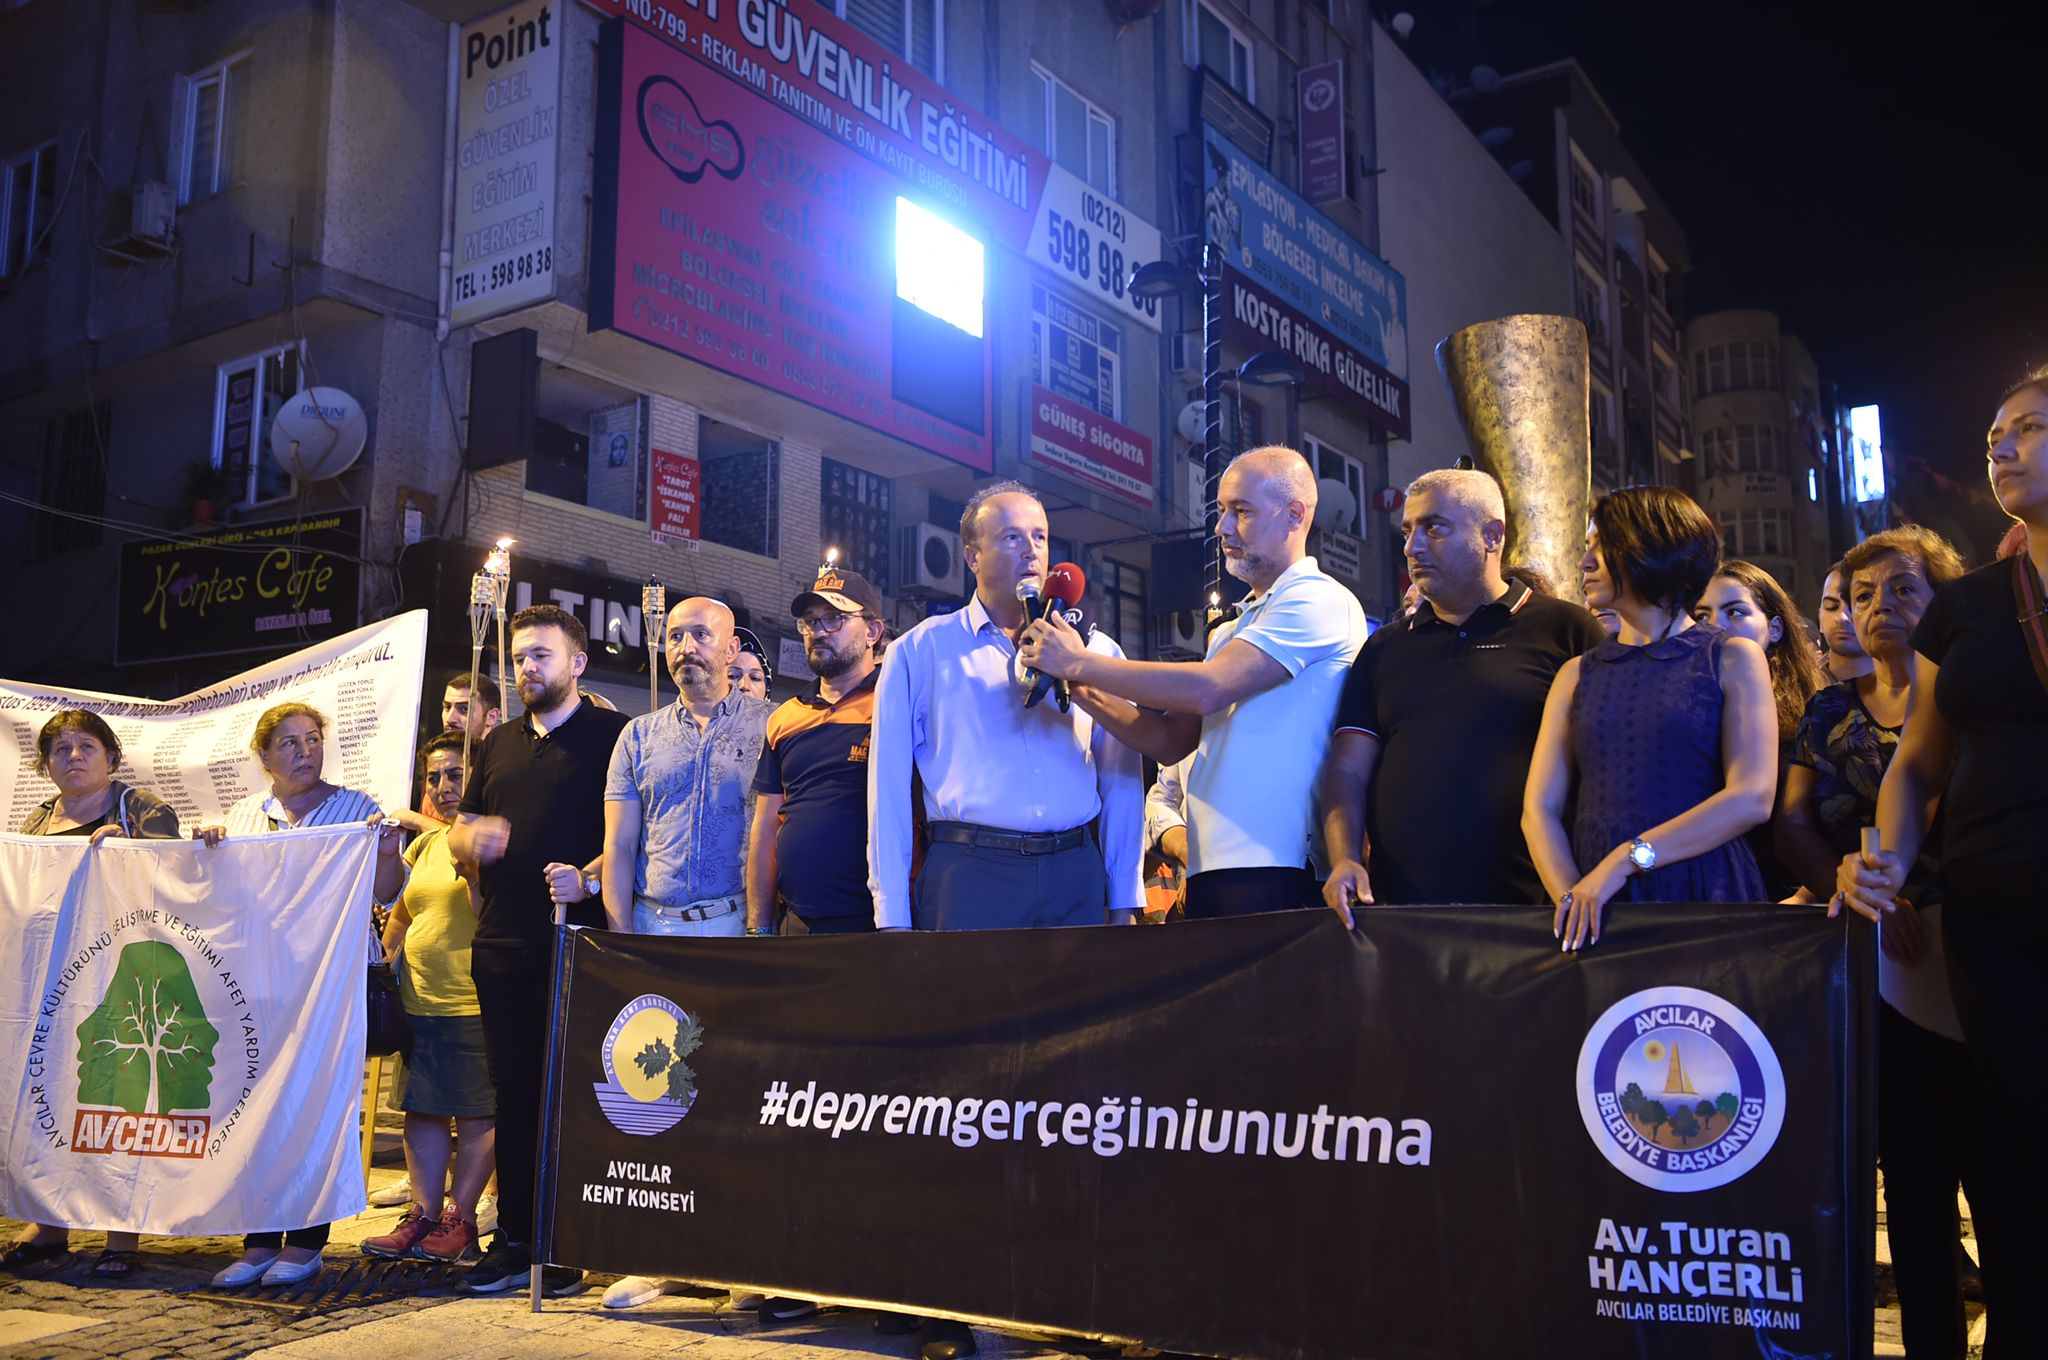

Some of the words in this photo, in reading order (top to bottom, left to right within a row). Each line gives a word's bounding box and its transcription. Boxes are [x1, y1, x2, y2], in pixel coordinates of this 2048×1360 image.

[466, 5, 551, 79] Point
[483, 70, 532, 114] ÖZEL
[702, 32, 766, 90] REKLAM
[770, 73, 832, 129] TANITIM
[835, 112, 853, 142] VE
[856, 122, 876, 155] ÖN
[880, 139, 915, 178] KAYIT
[737, 0, 913, 141] GÜVENLİK
[921, 101, 1028, 211] EĞİTİMİ
[459, 105, 555, 170] GÜVENLİK
[472, 161, 538, 215] EĞİTİM
[1082, 191, 1126, 244] (0212)
[1231, 157, 1297, 231] EPİLASYON
[462, 203, 545, 263] MERKEZİ
[1048, 209, 1090, 280] 598
[1098, 240, 1125, 300] 98
[455, 274, 477, 302] TEL
[490, 258, 514, 291] 598
[517, 253, 533, 283] 98
[536, 247, 552, 275] 38
[1262, 221, 1319, 287] BÖLGESEL
[1320, 257, 1365, 317] İNCELME
[1233, 282, 1291, 351] KOSTA
[1294, 322, 1331, 374] RİKA
[1335, 352, 1401, 419] GÜZELLİK
[1039, 403, 1087, 443] GÜNEŞ
[1090, 426, 1145, 467] SİGORTA
[142, 561, 248, 631] Kontes
[256, 547, 333, 610] Cafe
[308, 607, 333, 625] ÖZEL
[21, 695, 58, 713] 1999
[164, 912, 180, 930] VE
[180, 925, 224, 968] EĞİTİMİ
[42, 931, 113, 1017] KÜLTÜRÜNÜ
[219, 971, 247, 1008] AFET
[29, 1023, 50, 1078] ÇEVRE
[240, 1012, 260, 1080] YARDIM
[607, 1026, 620, 1075] AVCILAR
[619, 1001, 640, 1026] KENT
[641, 997, 678, 1016] KONSEYİ
[1633, 1007, 1716, 1036] AVCILAR
[31, 1084, 68, 1150] AVCILAR
[77, 1113, 205, 1155] AVCEDER
[208, 1086, 252, 1161] DERNEĞİ
[758, 1080, 1434, 1167] #depremgerçeğiniunutma
[1597, 1091, 1662, 1166] BELEDİYE
[582, 1183, 624, 1204] KENT
[627, 1188, 695, 1214] KONSEYİ
[606, 1160, 672, 1185] AVCILAR
[1596, 1298, 1655, 1321] AVCILAR
[1658, 1302, 1731, 1325] BELEDİYE
[1733, 1306, 1801, 1331] BAŞKANI
